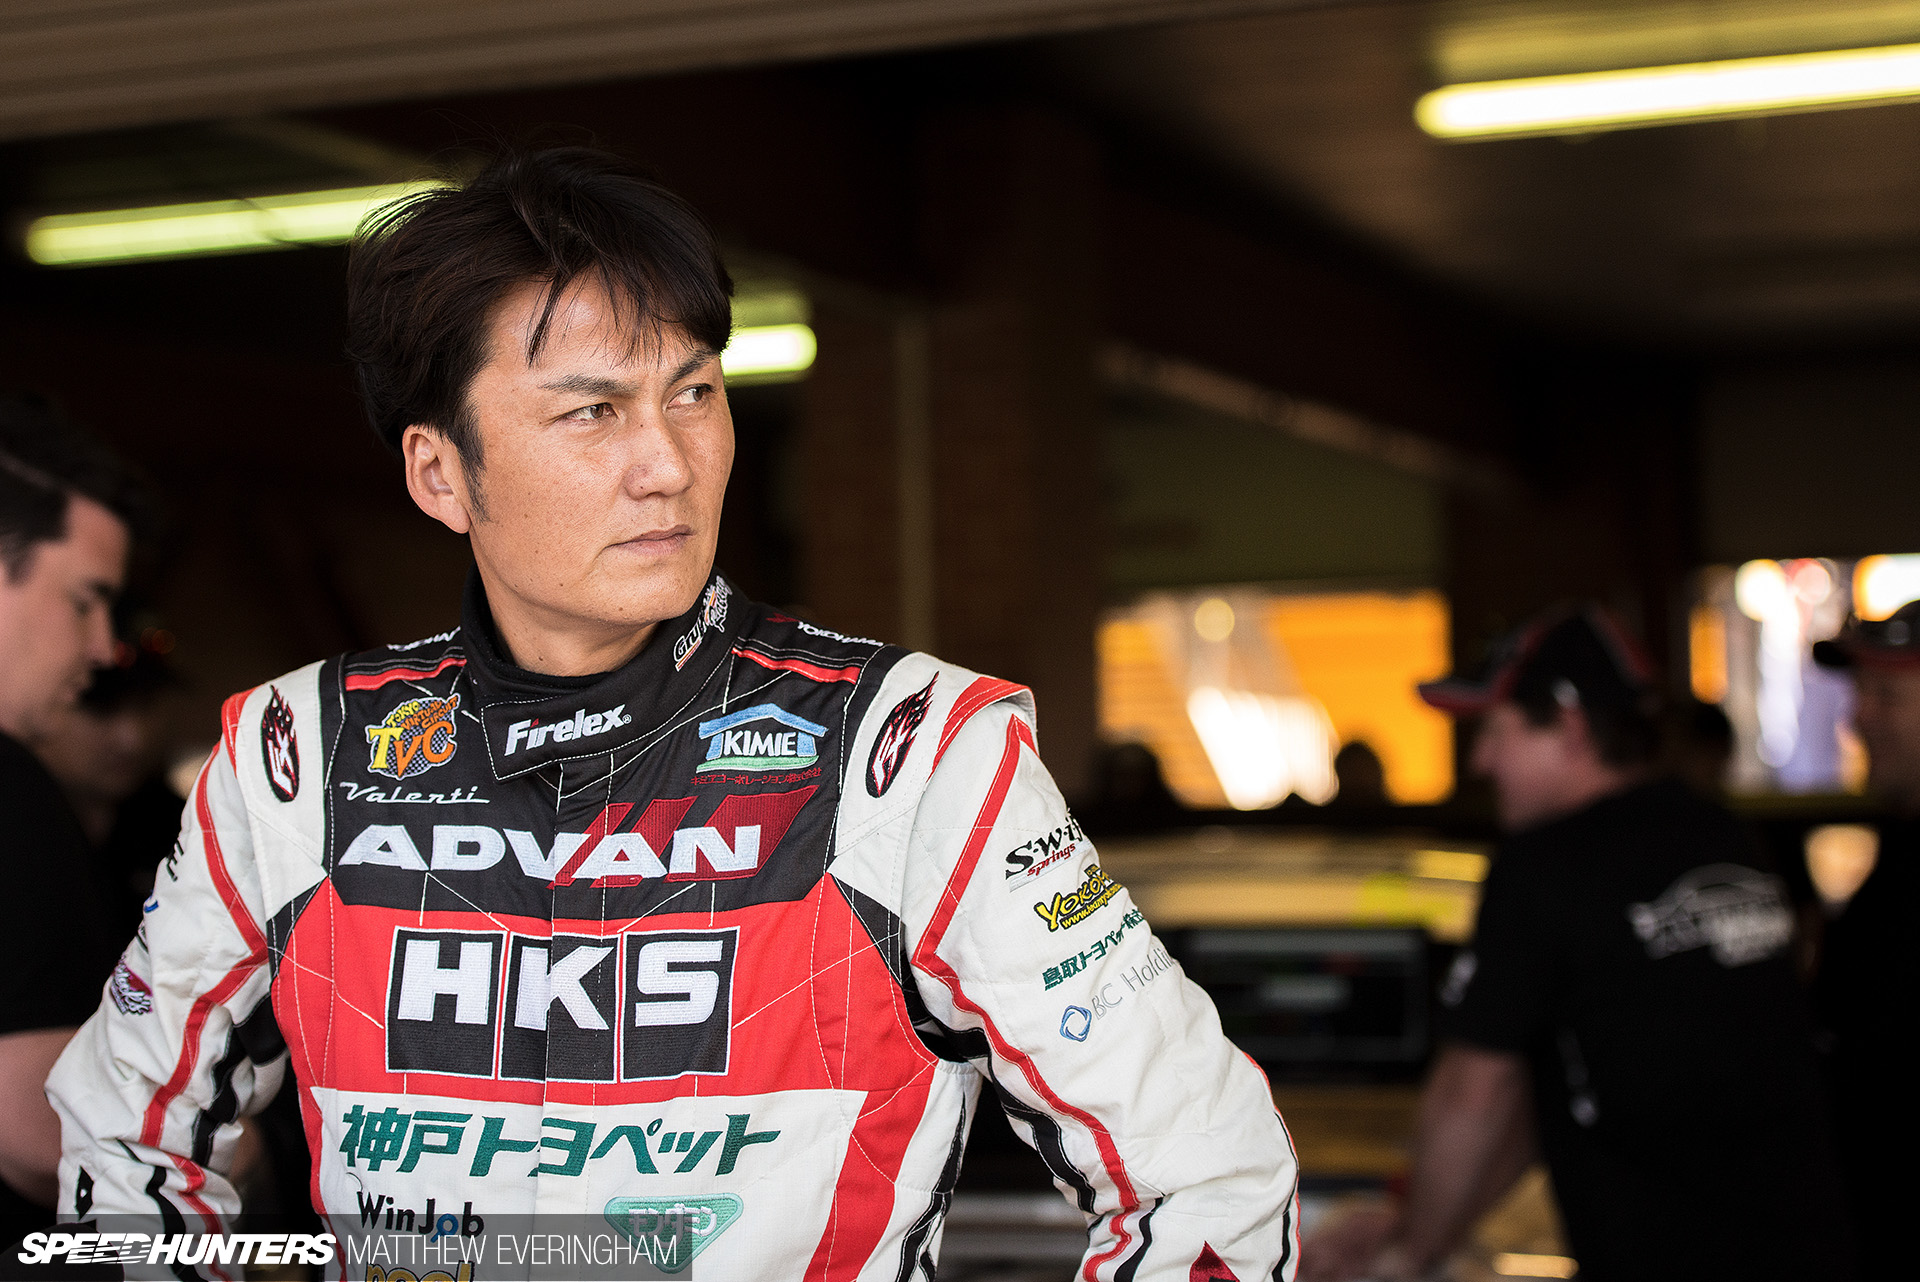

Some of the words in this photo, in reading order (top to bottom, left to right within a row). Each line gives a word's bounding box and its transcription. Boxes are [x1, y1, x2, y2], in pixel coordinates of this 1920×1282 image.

[386, 700, 420, 728] TOKYO
[421, 696, 458, 729] CIRCUIT
[368, 720, 455, 778] TVC
[723, 729, 797, 757] KIMIE
[339, 781, 490, 804] Valenti
[339, 823, 762, 881] ADVAN
[1027, 843, 1076, 876] springs
[397, 939, 724, 1031] HKS
[1091, 982, 1123, 1020] BC
[339, 1104, 782, 1178] 神戸トヨペット
